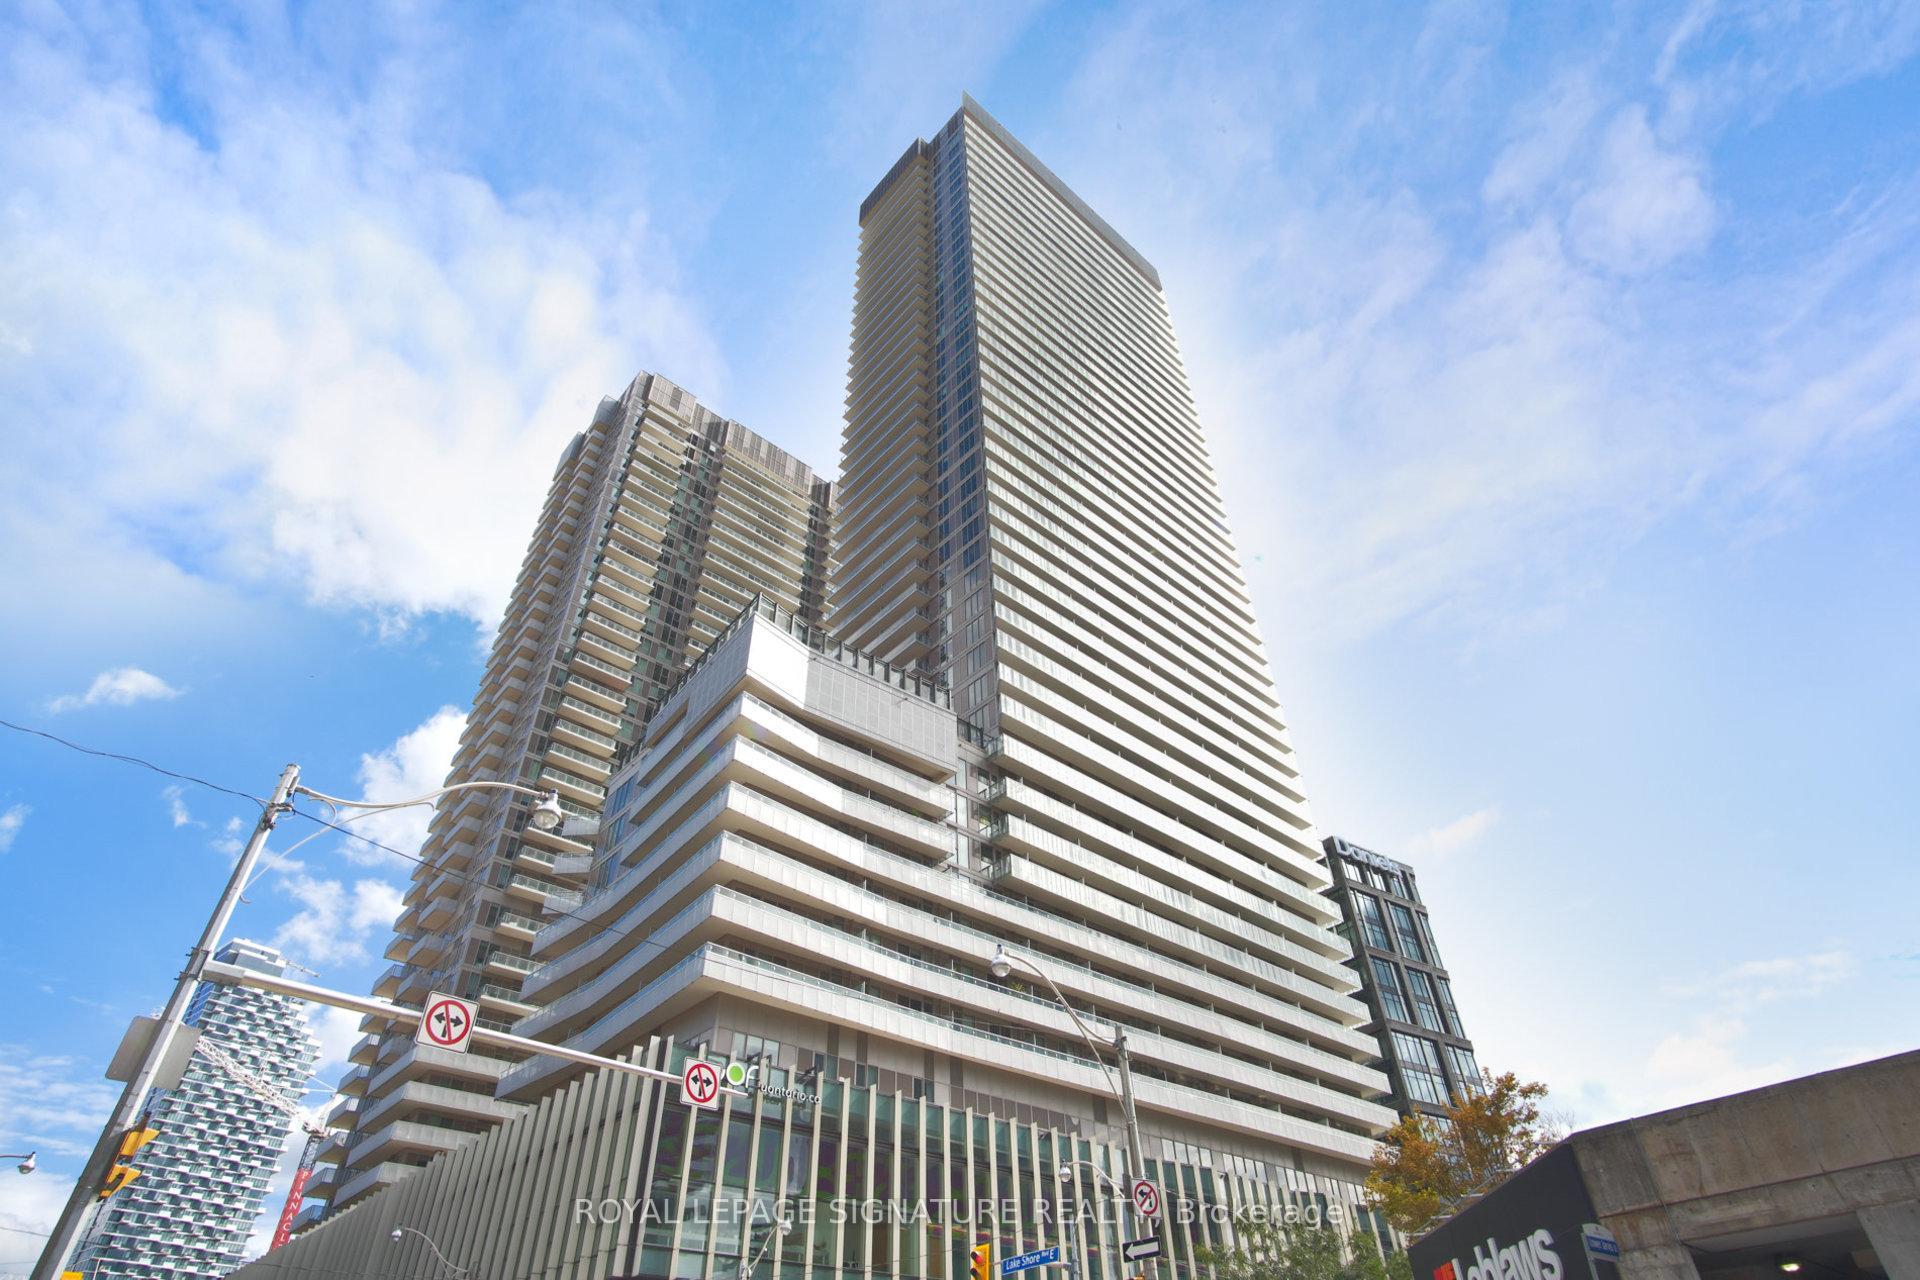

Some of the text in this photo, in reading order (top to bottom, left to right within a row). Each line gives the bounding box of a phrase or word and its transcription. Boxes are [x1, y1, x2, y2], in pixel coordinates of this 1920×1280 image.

[278, 1171, 308, 1247] PINNACL
[1006, 1258, 1021, 1270] Lake
[1021, 1254, 1041, 1266] Shore
[1049, 1248, 1055, 1260] E
